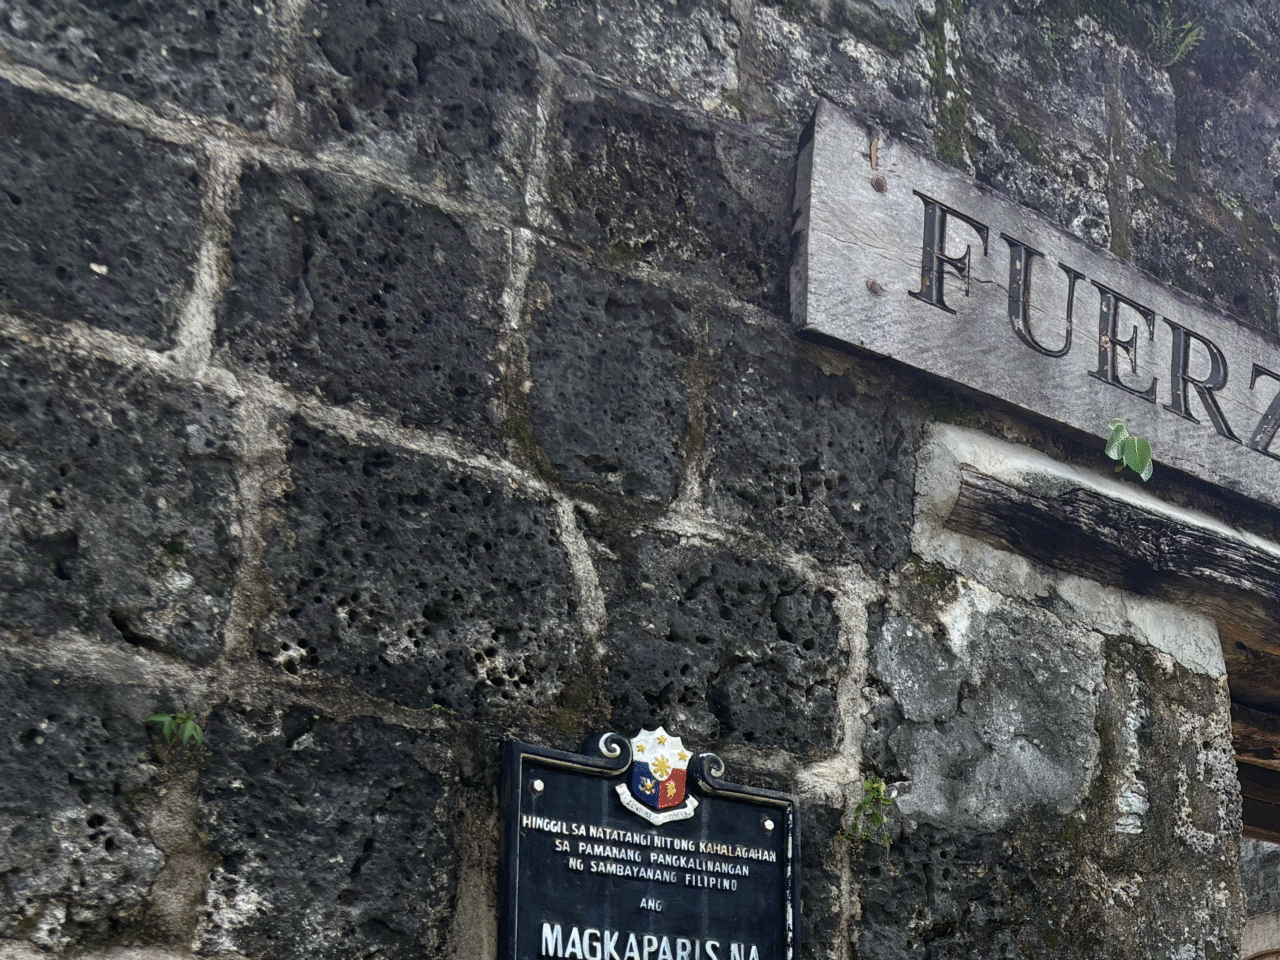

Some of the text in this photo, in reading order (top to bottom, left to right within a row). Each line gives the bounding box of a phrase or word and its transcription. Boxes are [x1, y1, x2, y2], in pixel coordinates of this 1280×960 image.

[522, 815, 777, 863] HINGGIL SA NATATANGI NITONG KAHALAGAHAN
[555, 839, 750, 877] SA PAMANANG PANGKALINANGAN
[568, 857, 738, 892] NG SAMBAYANANG FILIPINO
[639, 897, 662, 912] ANG
